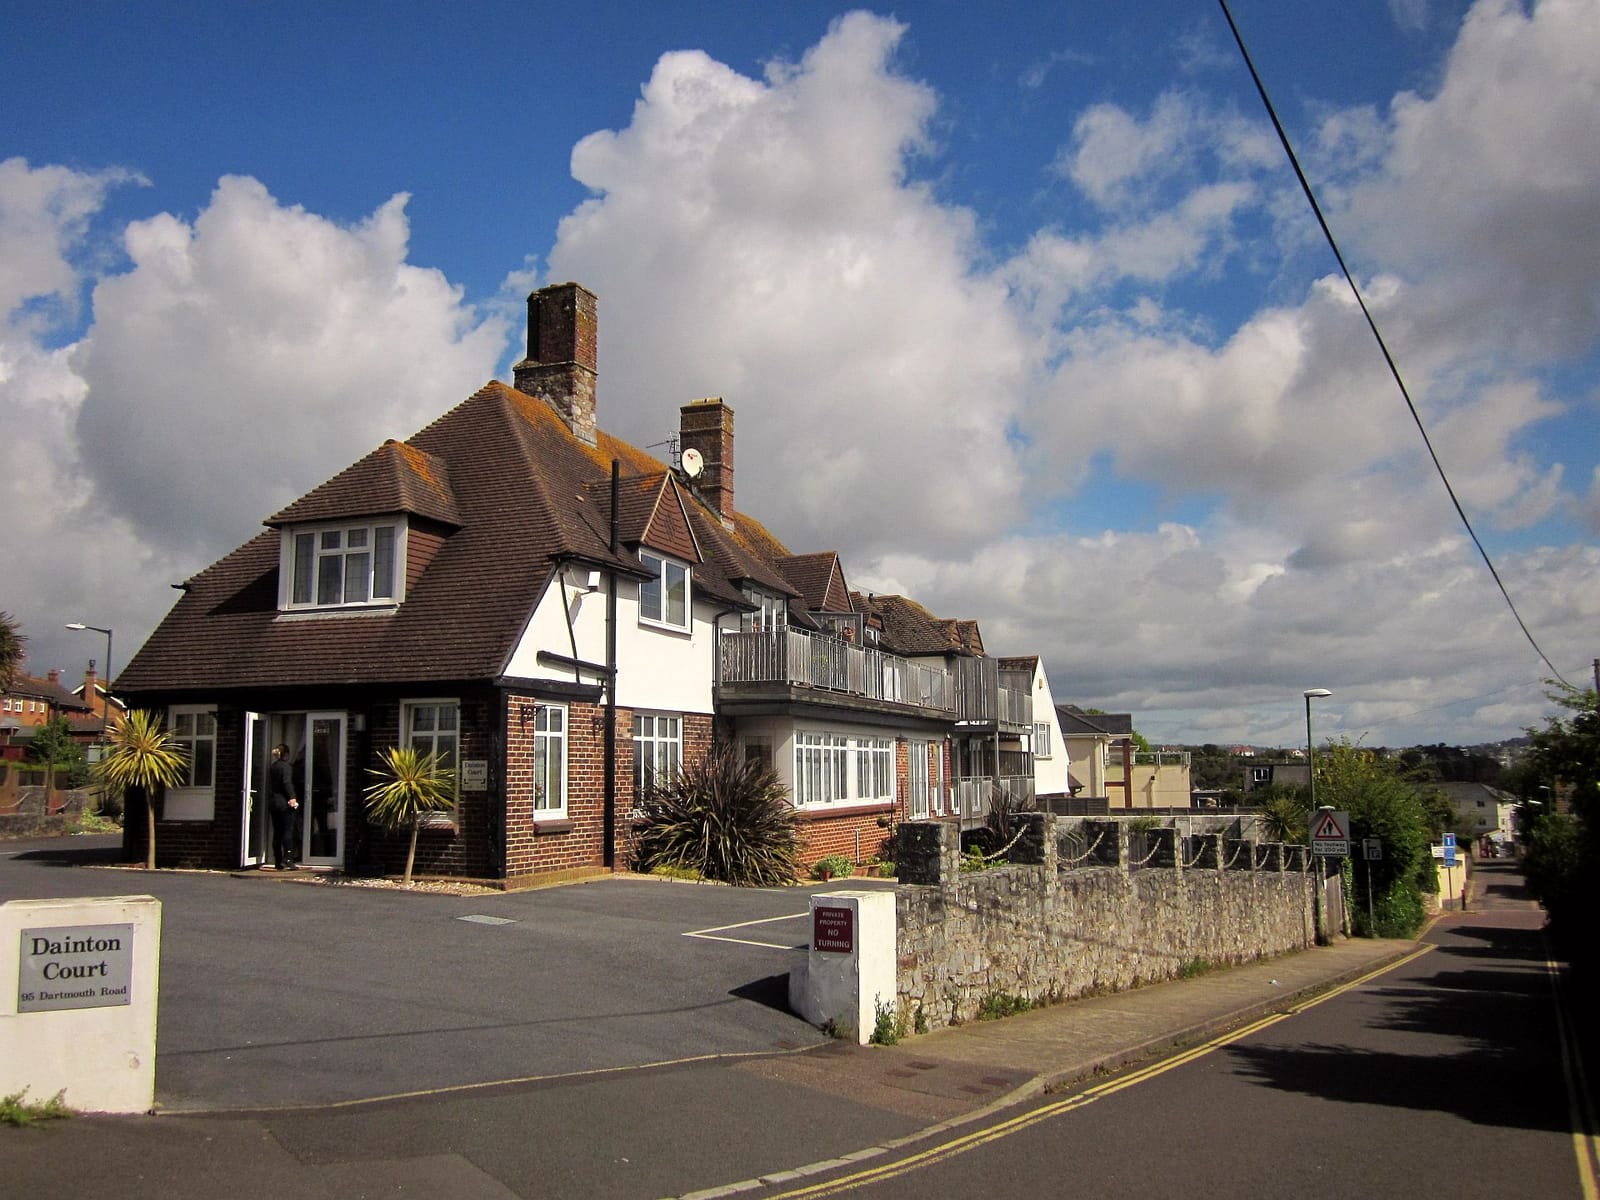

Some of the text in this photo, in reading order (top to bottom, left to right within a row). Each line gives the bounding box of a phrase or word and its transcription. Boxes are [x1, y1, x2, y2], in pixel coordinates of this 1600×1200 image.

[827, 928, 839, 936] NO
[31, 936, 121, 956] Dainton
[818, 939, 850, 948] TURNING
[43, 961, 108, 980] Court
[21, 986, 127, 1001] 95 Dartmouth Road
